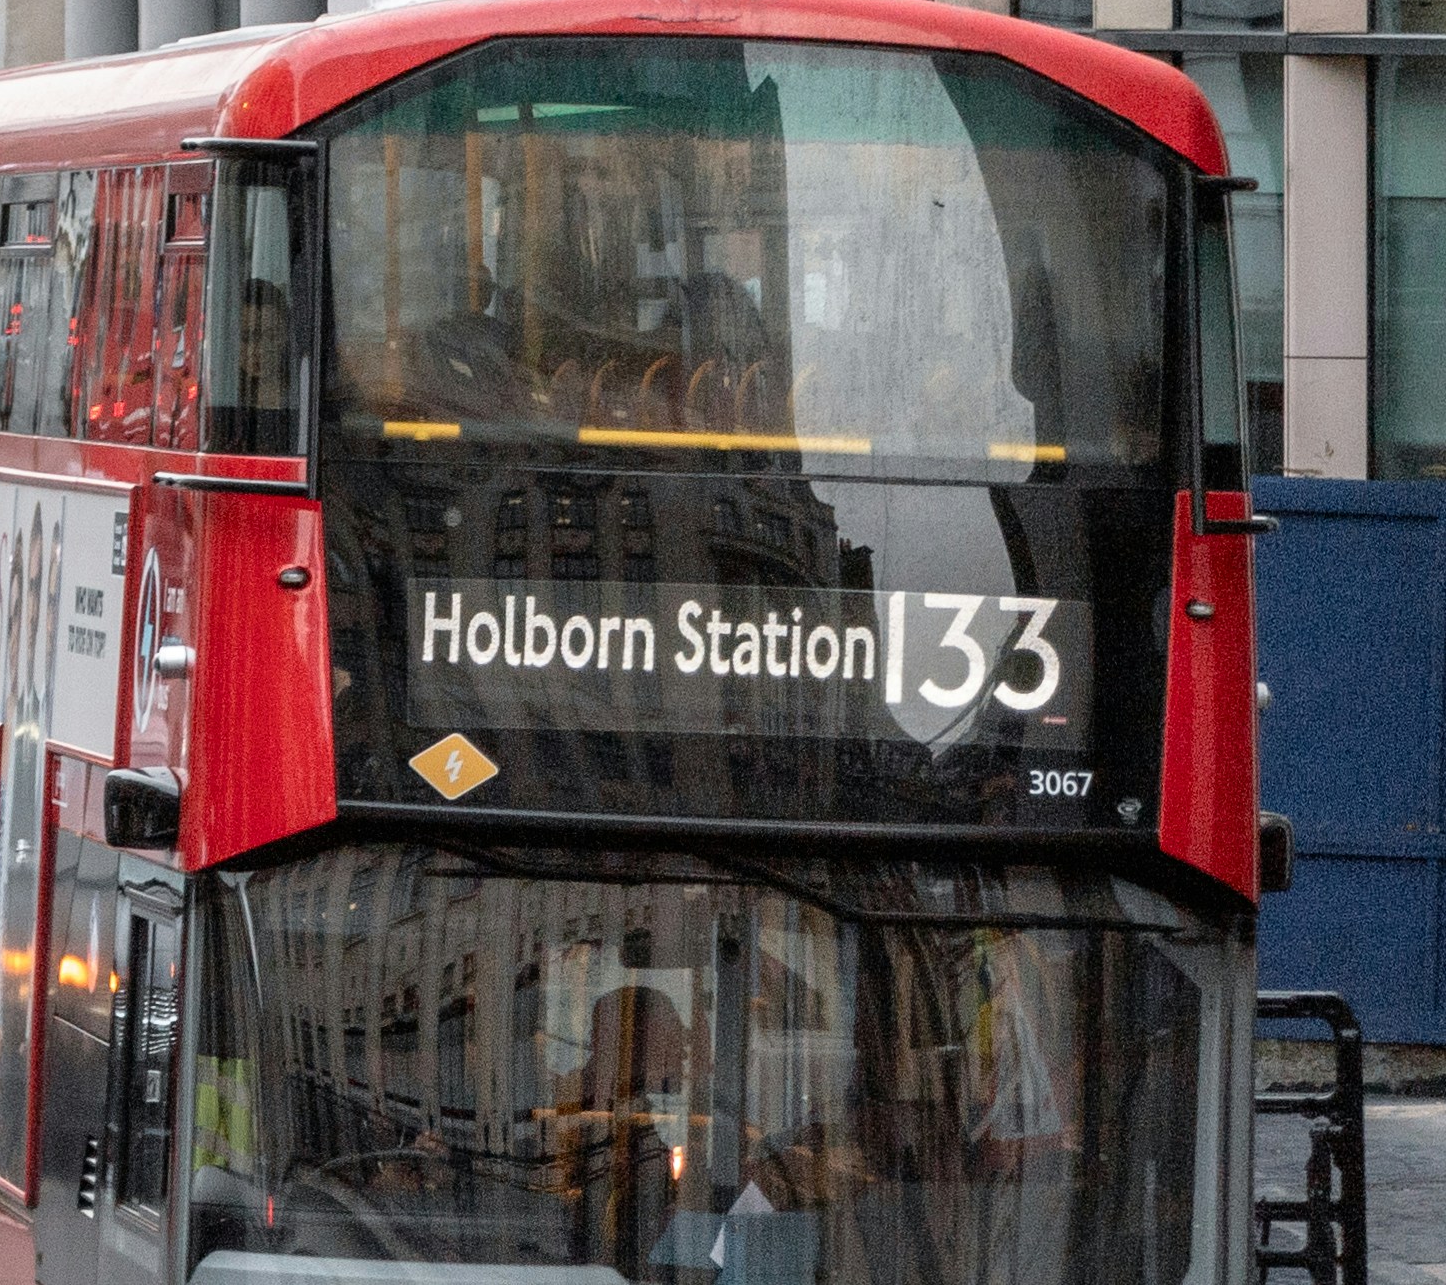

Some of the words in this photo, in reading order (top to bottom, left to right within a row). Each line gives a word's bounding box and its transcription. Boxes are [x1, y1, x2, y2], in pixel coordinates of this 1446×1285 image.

[422, 591, 655, 672] Holborn
[674, 599, 875, 681] Station
[884, 590, 1060, 711] 133
[1029, 770, 1093, 798] 3067
